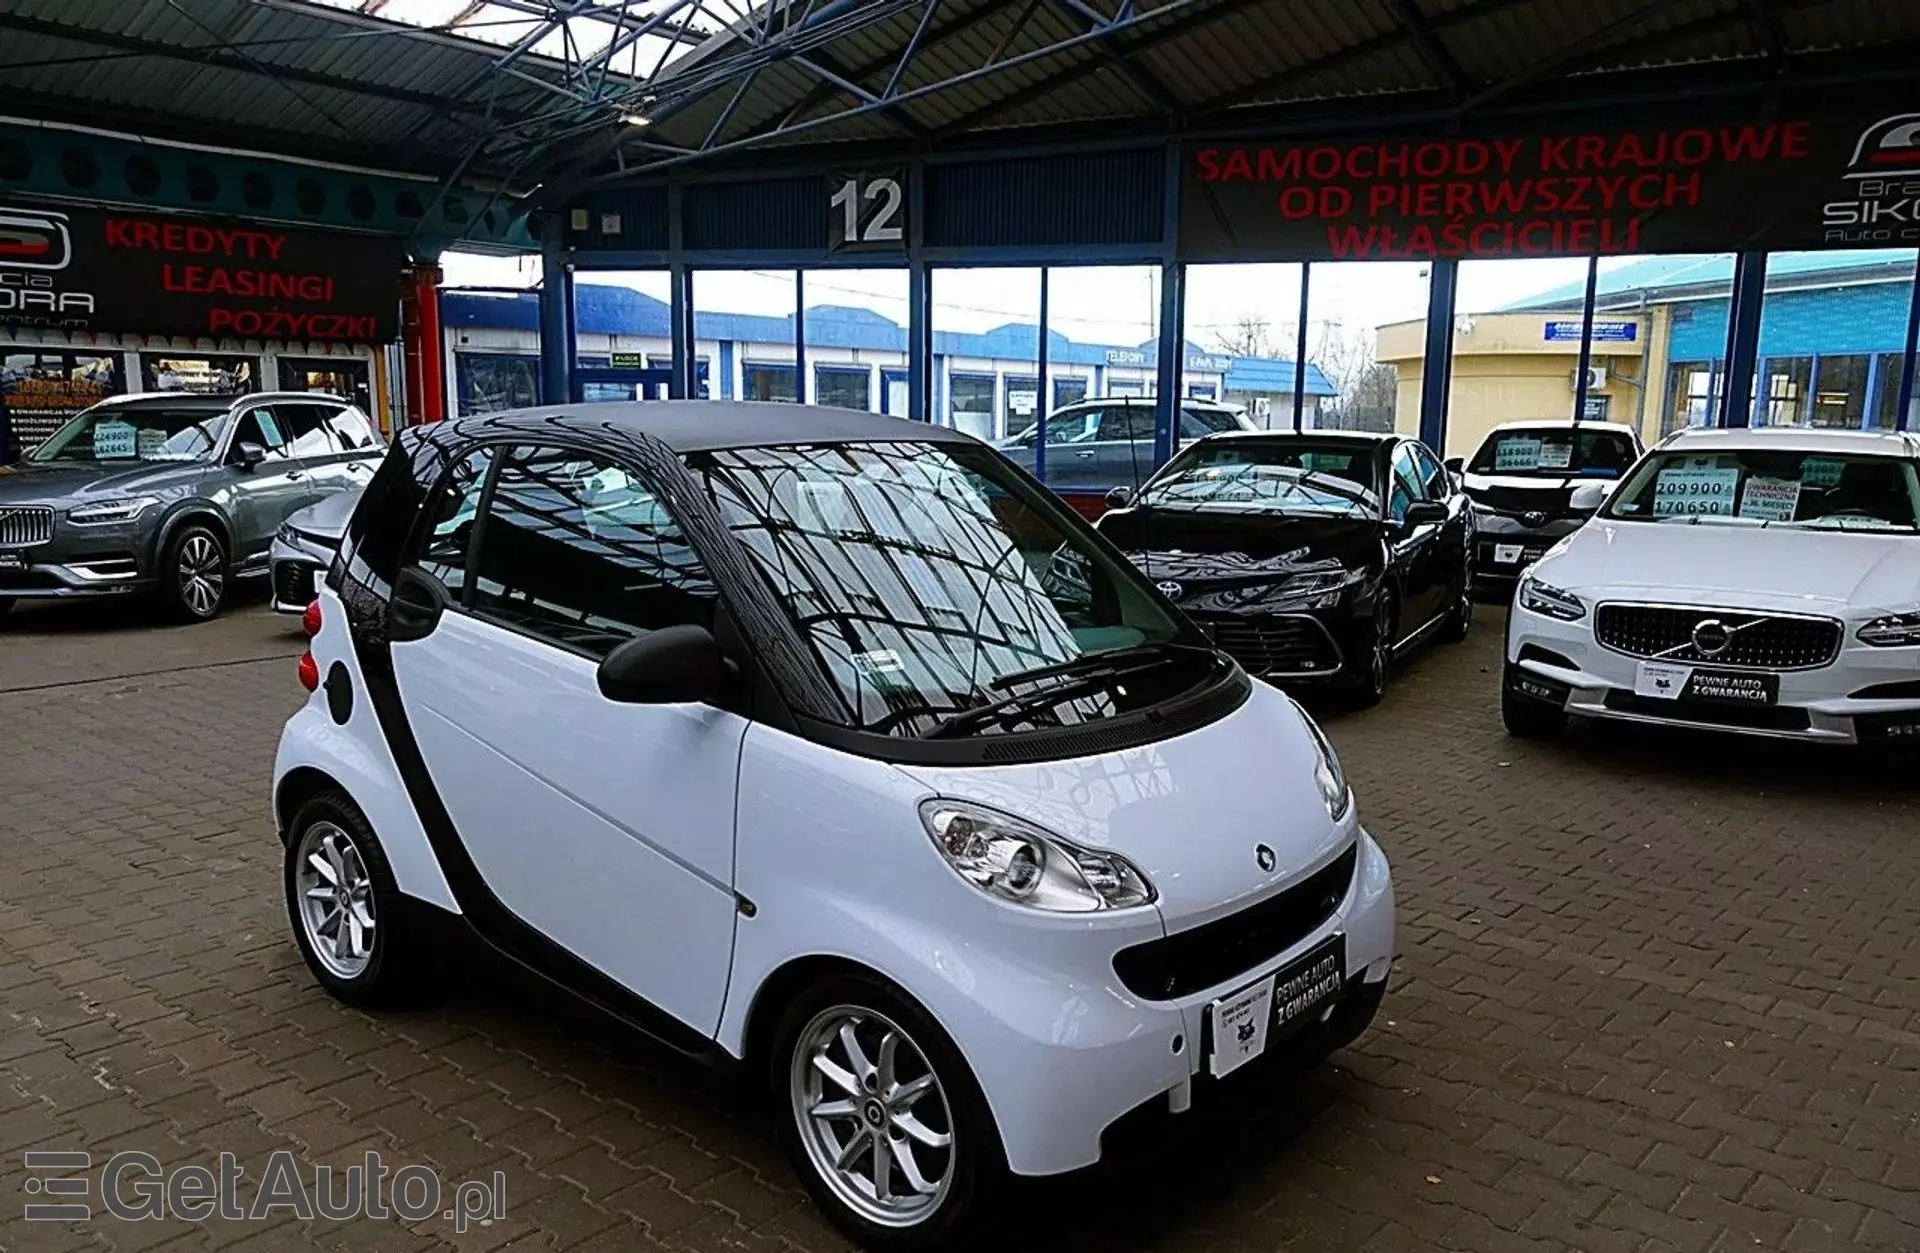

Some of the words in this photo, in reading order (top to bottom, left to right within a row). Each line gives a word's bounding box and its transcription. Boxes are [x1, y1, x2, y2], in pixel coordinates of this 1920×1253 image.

[1196, 137, 1525, 183] SAMOCHODY
[1539, 119, 1811, 171] KRAJOWE
[831, 178, 903, 241] 12
[1279, 183, 1353, 221] OD
[1370, 171, 1701, 217] PIERWSZYCH
[1822, 198, 1920, 225] SIK
[105, 218, 285, 260] KREDYTY
[1327, 213, 1641, 258] WŁAŚCICIELI
[162, 263, 335, 301] LEASINGI
[209, 306, 377, 339] POŻYCZKI
[1657, 482, 1721, 495] 209900
[1654, 501, 1719, 514] 170650
[1692, 675, 1730, 687] PEWNE
[1731, 677, 1762, 690] AUTO
[1692, 685, 1700, 695] Z
[1701, 685, 1768, 703] GWARANCJĄ
[1276, 970, 1310, 1005] PEWNE
[1310, 954, 1336, 983] AUTO
[1277, 1006, 1286, 1025] Z
